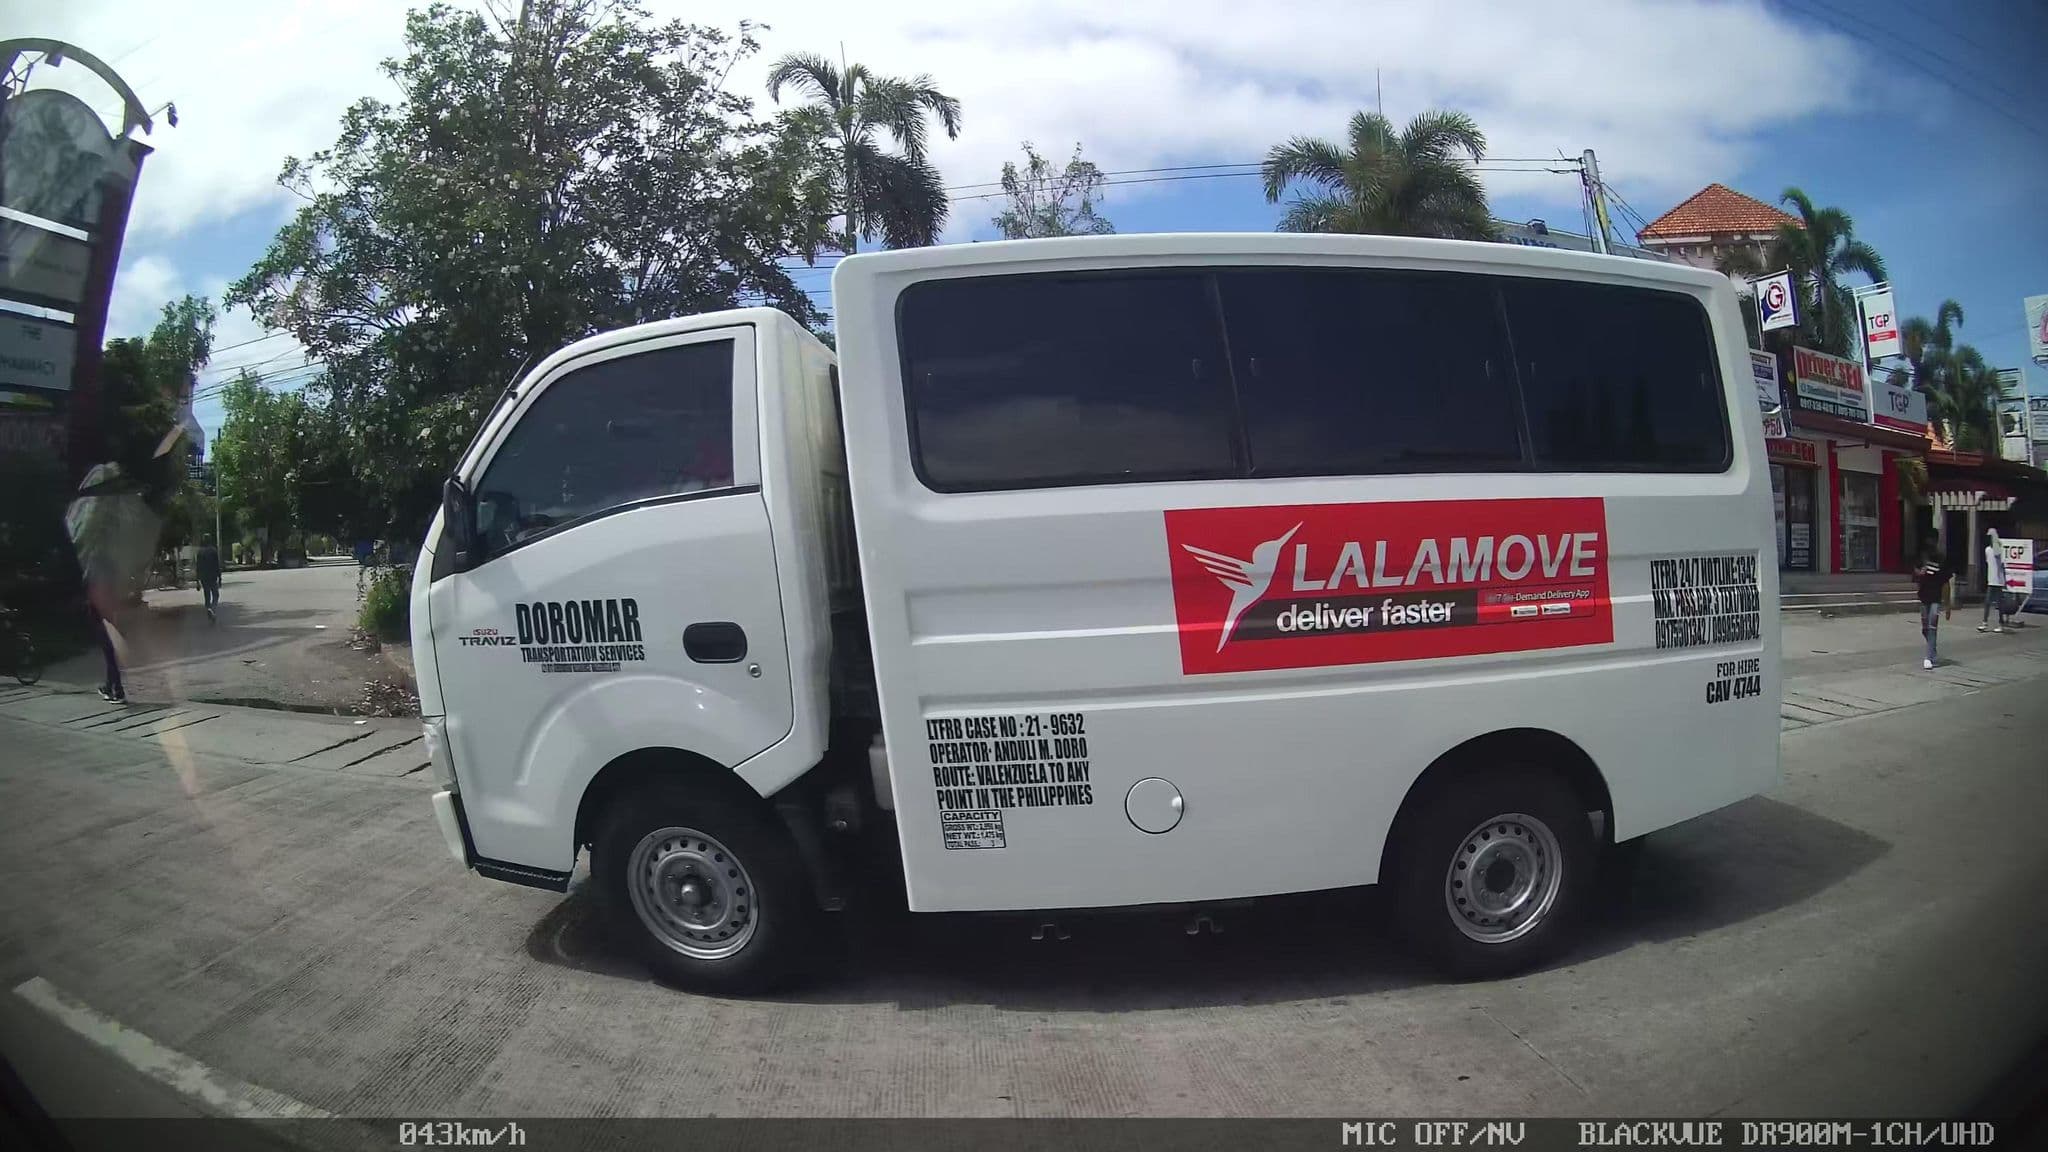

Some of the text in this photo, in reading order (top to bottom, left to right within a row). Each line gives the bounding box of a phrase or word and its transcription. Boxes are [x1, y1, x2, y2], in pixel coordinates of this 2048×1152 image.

[1868, 314, 1889, 329] TGP
[1888, 391, 1909, 414] TGP
[1292, 532, 1598, 591] LALAMOVE
[2003, 545, 2024, 560] TGP
[1650, 559, 1678, 590] LTFRB
[1679, 558, 1699, 588] 24/7
[1547, 590, 1575, 600] Delivery
[1576, 589, 1590, 599] App
[515, 598, 643, 645] DOROMAR
[1276, 599, 1455, 633] deliver faster
[459, 636, 518, 646] TRAVIZ
[473, 628, 498, 636] ISUZU
[521, 644, 645, 663] TRANSPORTATION SERVICES
[1717, 658, 1760, 678] FOR HIRE
[1706, 675, 1761, 704] CAV 4744
[927, 718, 962, 741] LTFRB
[965, 717, 998, 739] CASE
[999, 716, 1017, 738] NO
[1025, 715, 1041, 737] 21
[1050, 713, 1085, 736] 9632
[994, 739, 1037, 762] ANDULI
[1039, 738, 1053, 760] M.
[1054, 737, 1088, 759] DORO
[933, 761, 1090, 787] ROUTE: VALENZUELA TO ANY
[936, 784, 1093, 810] POINT IN THE PHILIPPINES
[943, 812, 999, 821] CAPACITY
[946, 832, 961, 840] NET
[996, 831, 1003, 840] kg
